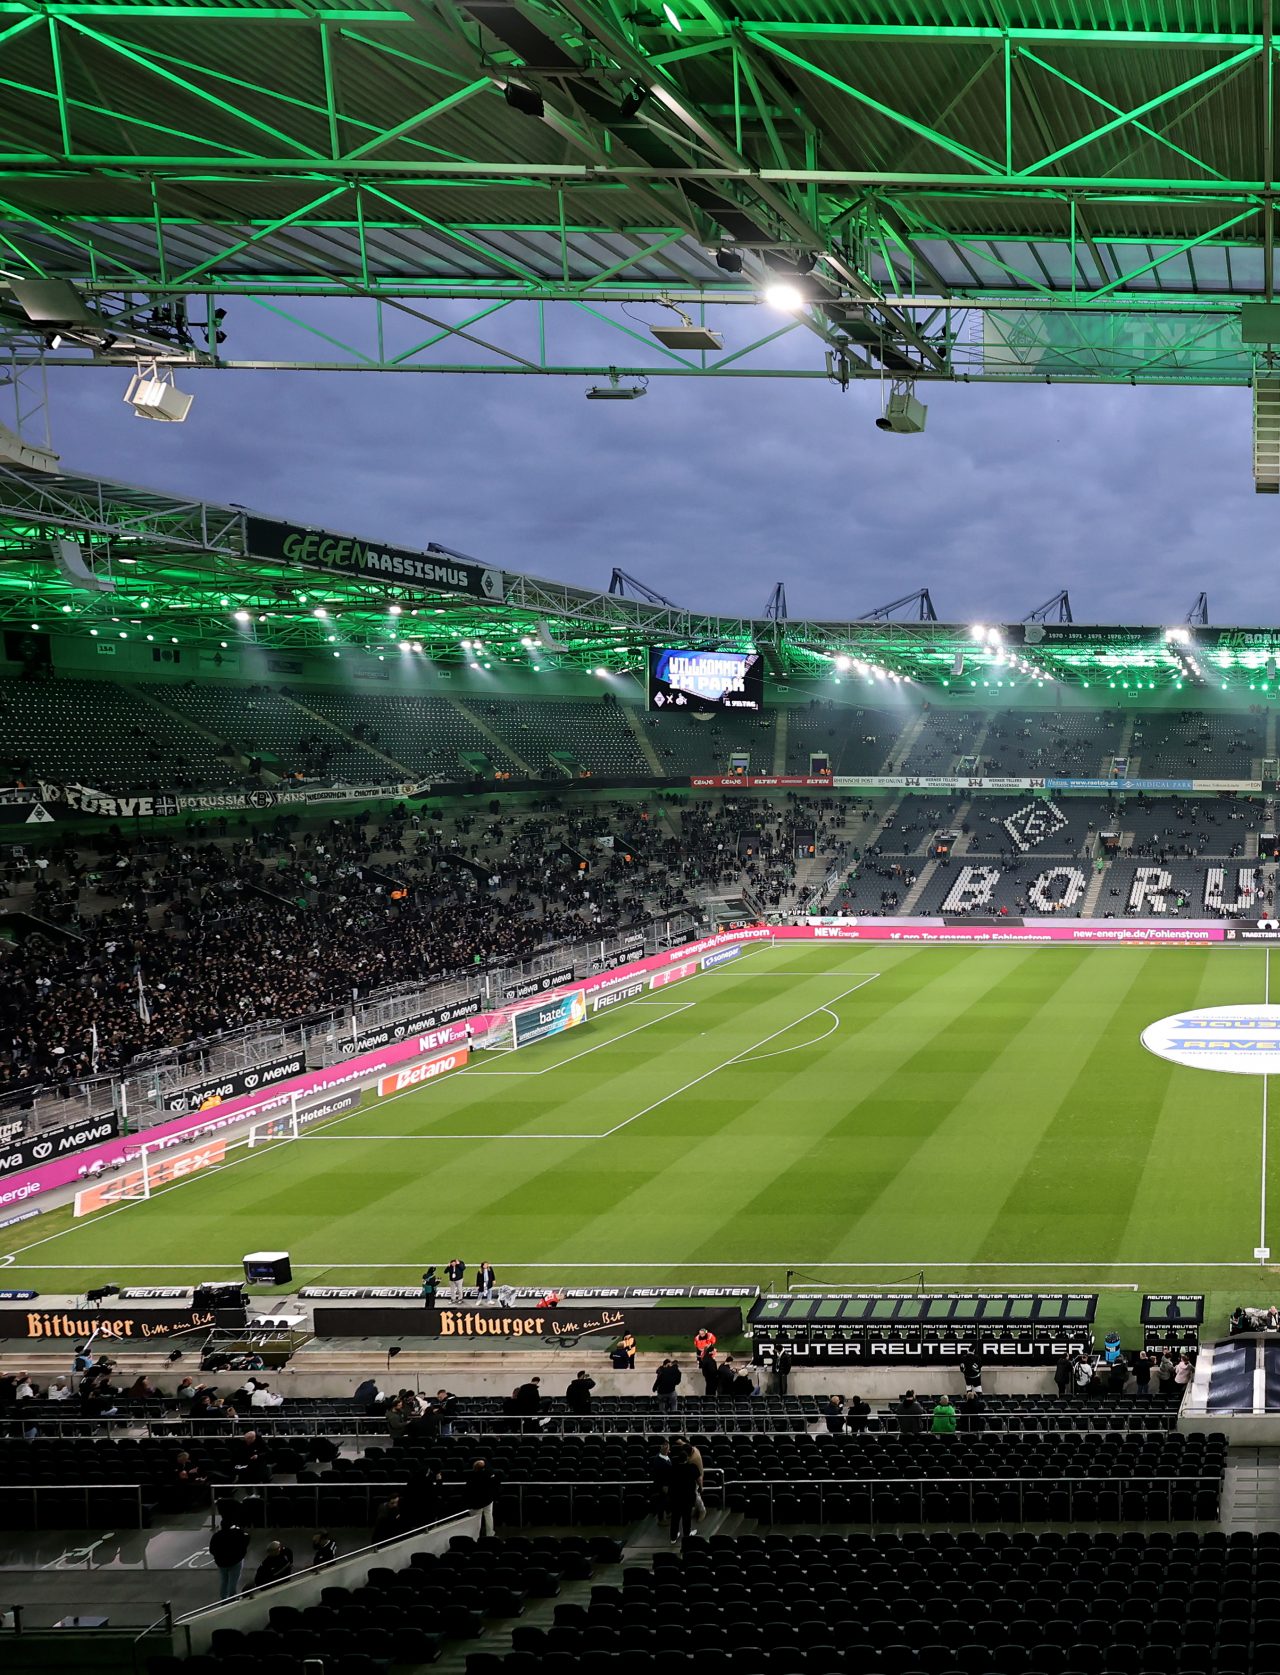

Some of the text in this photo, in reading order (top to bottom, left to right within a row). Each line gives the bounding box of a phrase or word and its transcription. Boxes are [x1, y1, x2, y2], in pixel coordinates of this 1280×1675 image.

[669, 657, 745, 677] WILLKOMMEN
[668, 673, 745, 692] IM PARK
[814, 927, 839, 937] NEW
[598, 983, 643, 1009] REUTER
[539, 1006, 567, 1025] batec
[419, 1029, 452, 1051] NEW
[396, 1057, 455, 1089] Betano
[126, 1288, 182, 1298] REUTER
[304, 1288, 358, 1297] REUTER
[567, 1288, 619, 1297] REUTER
[632, 1287, 685, 1296] REUTER
[698, 1287, 750, 1296] REUTER
[26, 1312, 135, 1338] Bitburger
[439, 1310, 546, 1337] Bitburger
[601, 1311, 625, 1325] Bit
[983, 1343, 1084, 1355] REUTER
